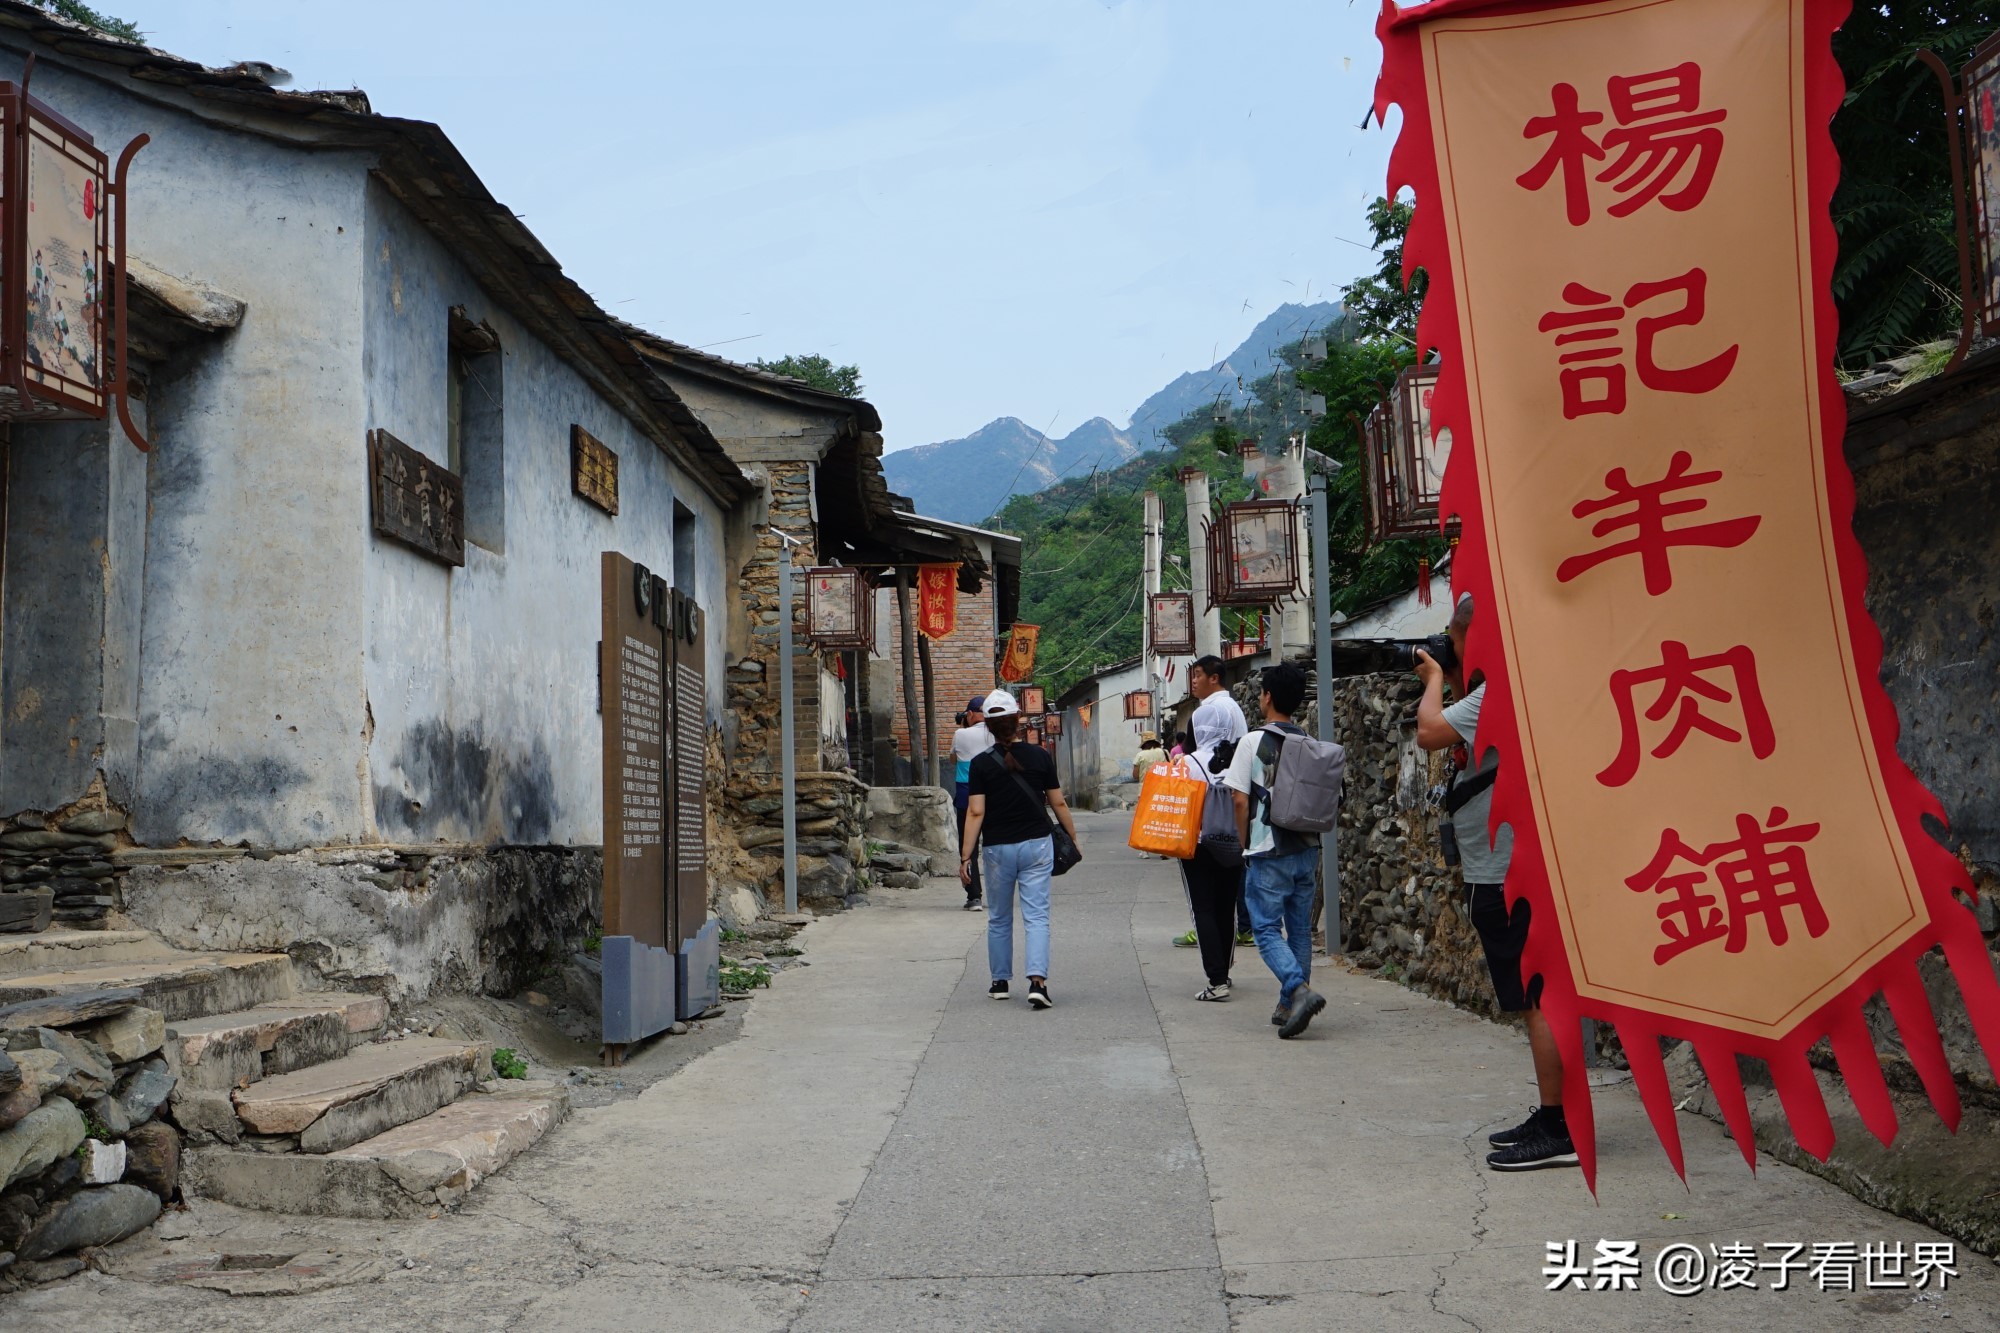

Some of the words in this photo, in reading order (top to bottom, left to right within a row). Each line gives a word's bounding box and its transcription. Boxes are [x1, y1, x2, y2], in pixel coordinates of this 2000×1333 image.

[1015, 636, 1032, 655] 商
[1516, 62, 1829, 966] 楊記羊肉鋪
